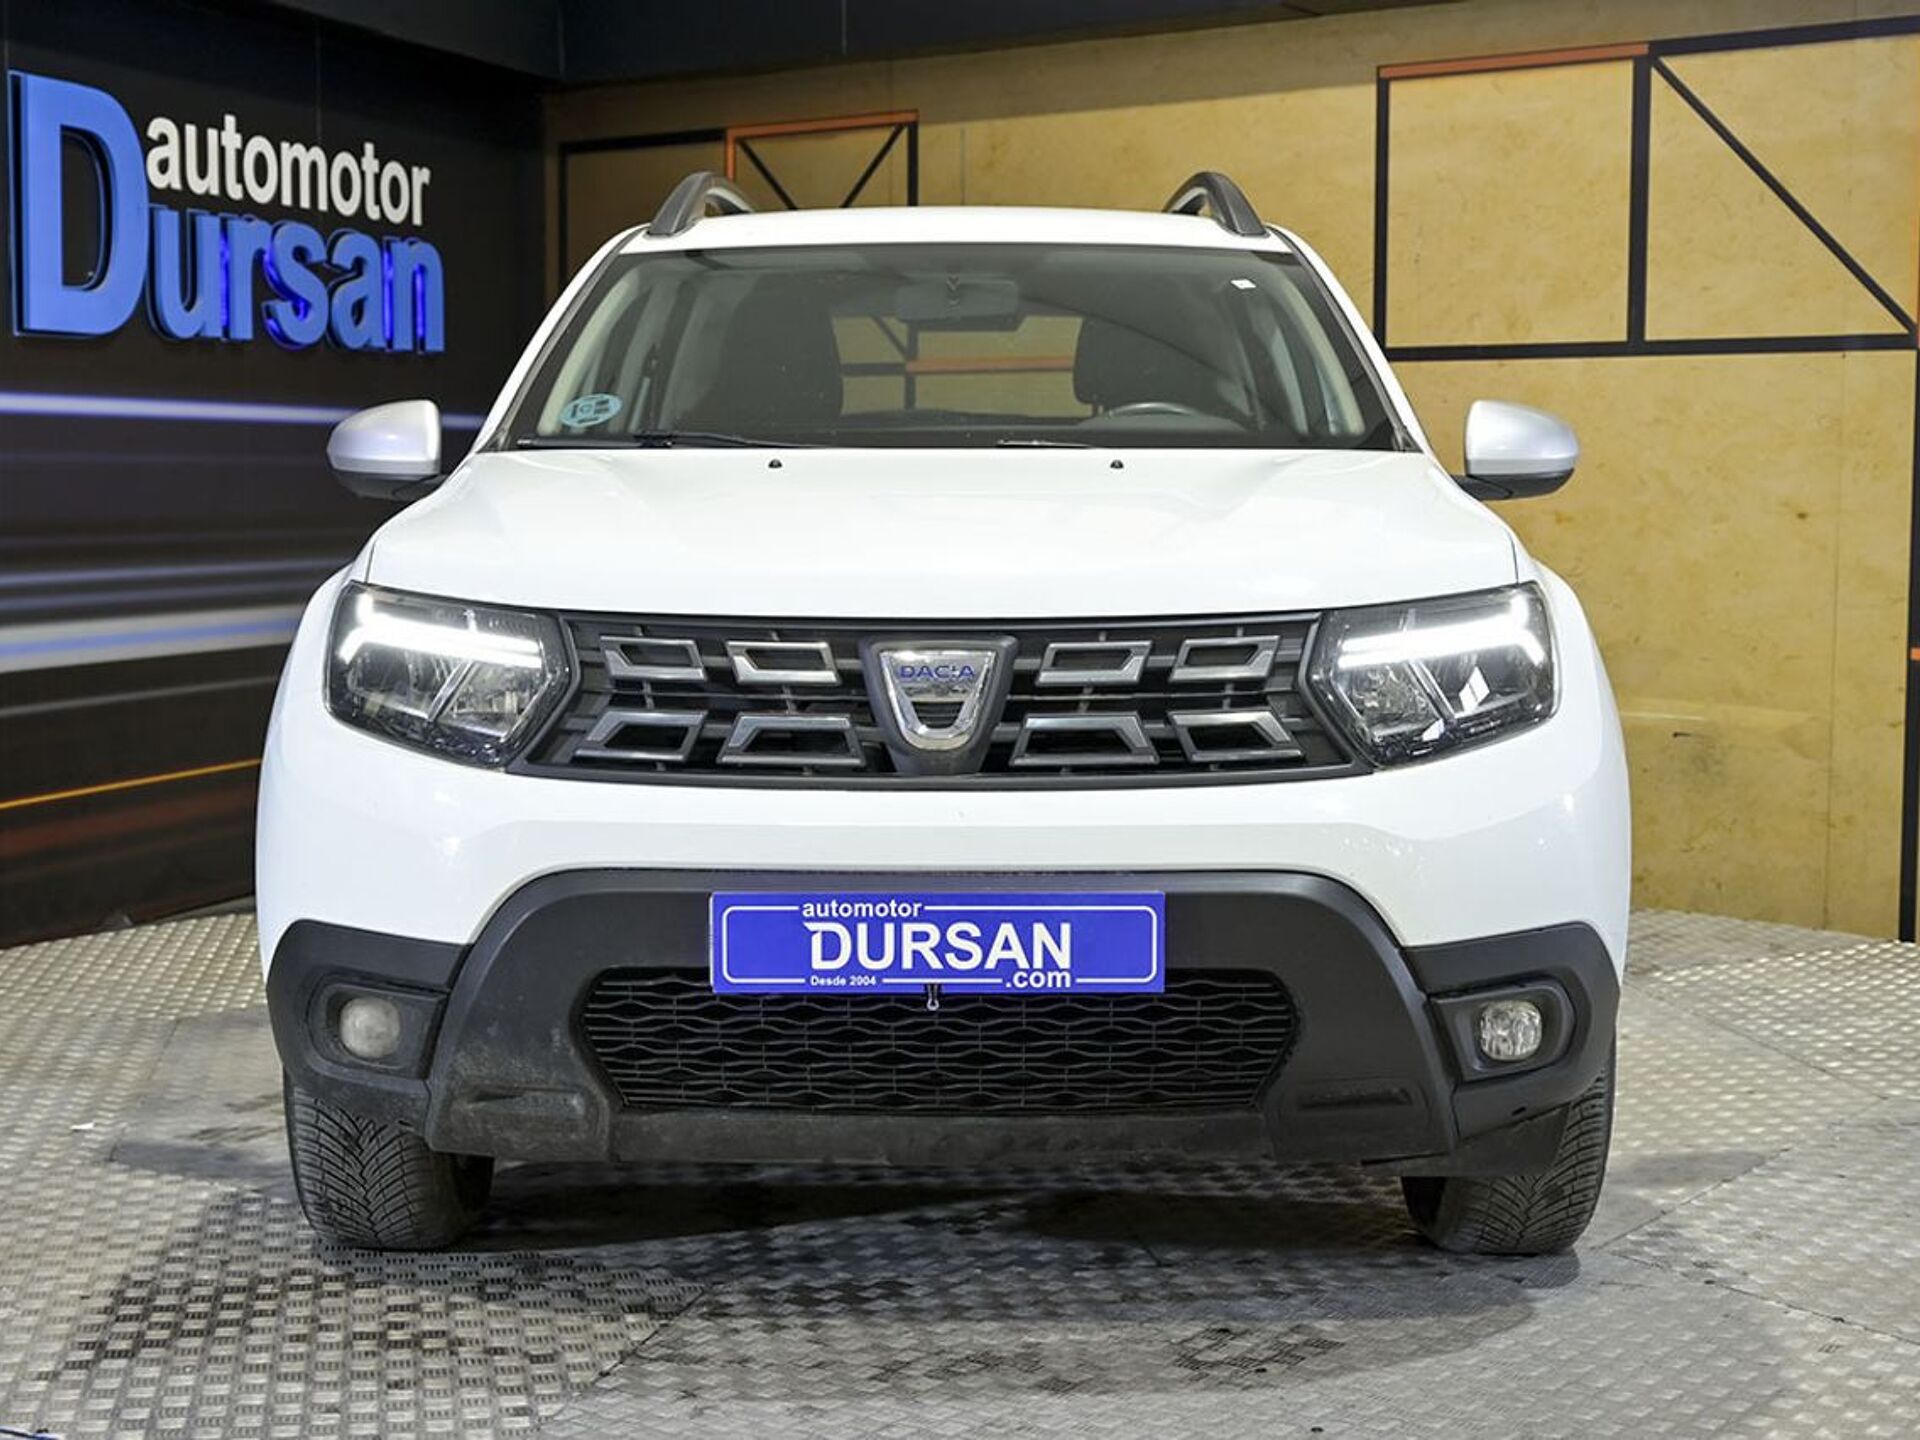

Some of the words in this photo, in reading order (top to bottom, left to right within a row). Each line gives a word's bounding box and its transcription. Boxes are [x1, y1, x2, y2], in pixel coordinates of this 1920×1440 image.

[145, 113, 431, 227] automotor
[7, 69, 446, 353] Dursan
[802, 899, 923, 918] automotor
[803, 922, 1071, 970] DURSAN
[811, 975, 847, 986] Desde
[849, 975, 877, 986] 2004
[1005, 970, 1071, 989] .com
